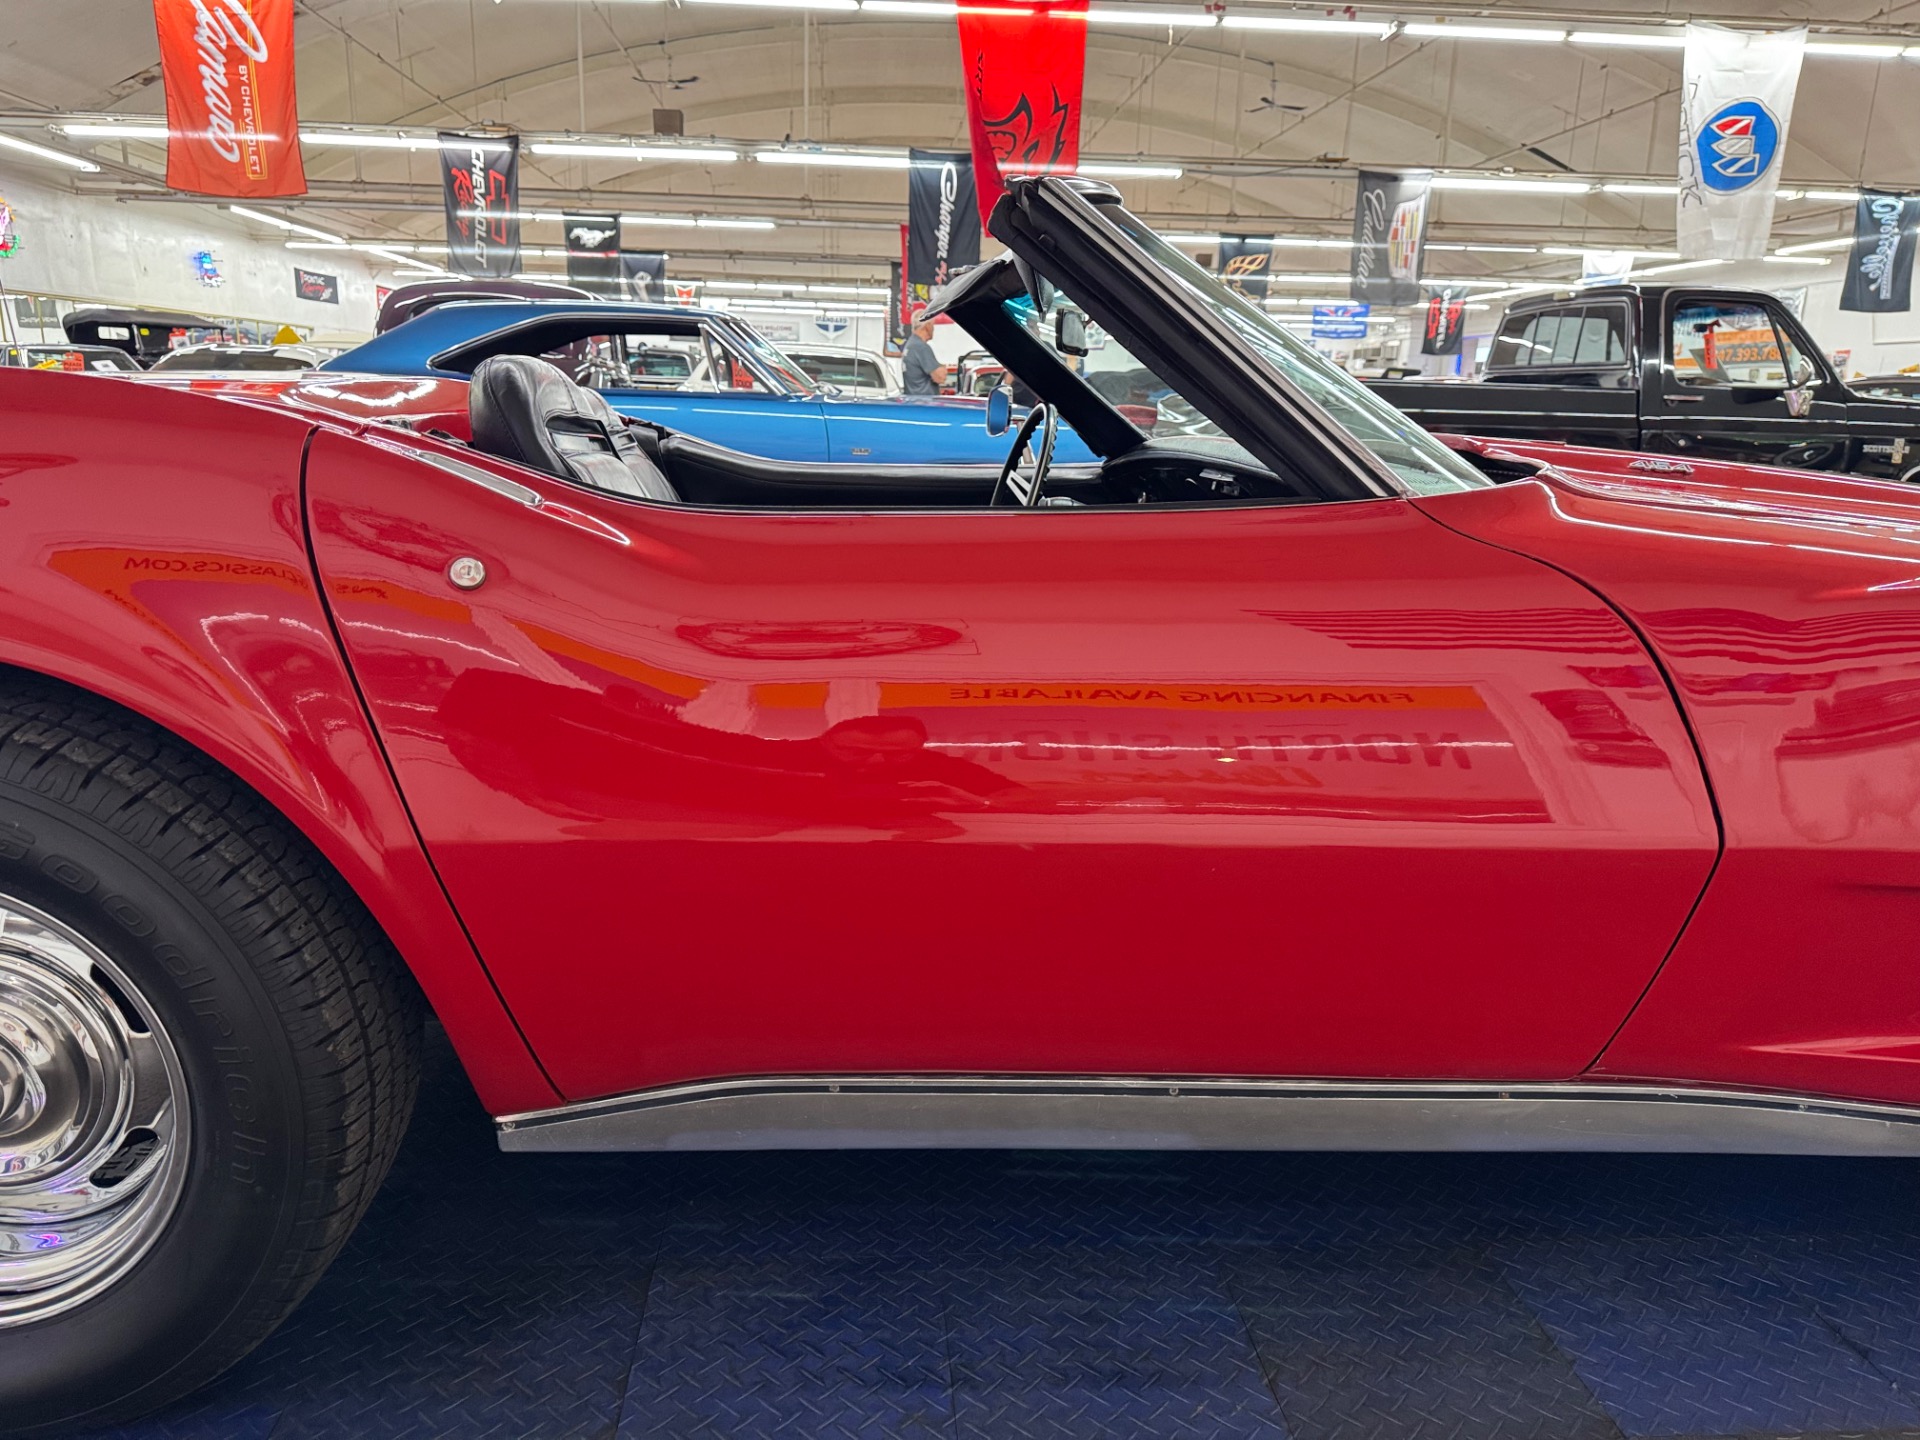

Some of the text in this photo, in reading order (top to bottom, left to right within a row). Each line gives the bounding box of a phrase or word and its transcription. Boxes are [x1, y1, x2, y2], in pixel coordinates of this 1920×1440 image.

[238, 65, 261, 173] BY CHEVROLET
[471, 148, 488, 268] CHEVROLET
[934, 161, 958, 259] Charger
[1356, 189, 1387, 289] Cadillac
[1628, 459, 1695, 473] 454
